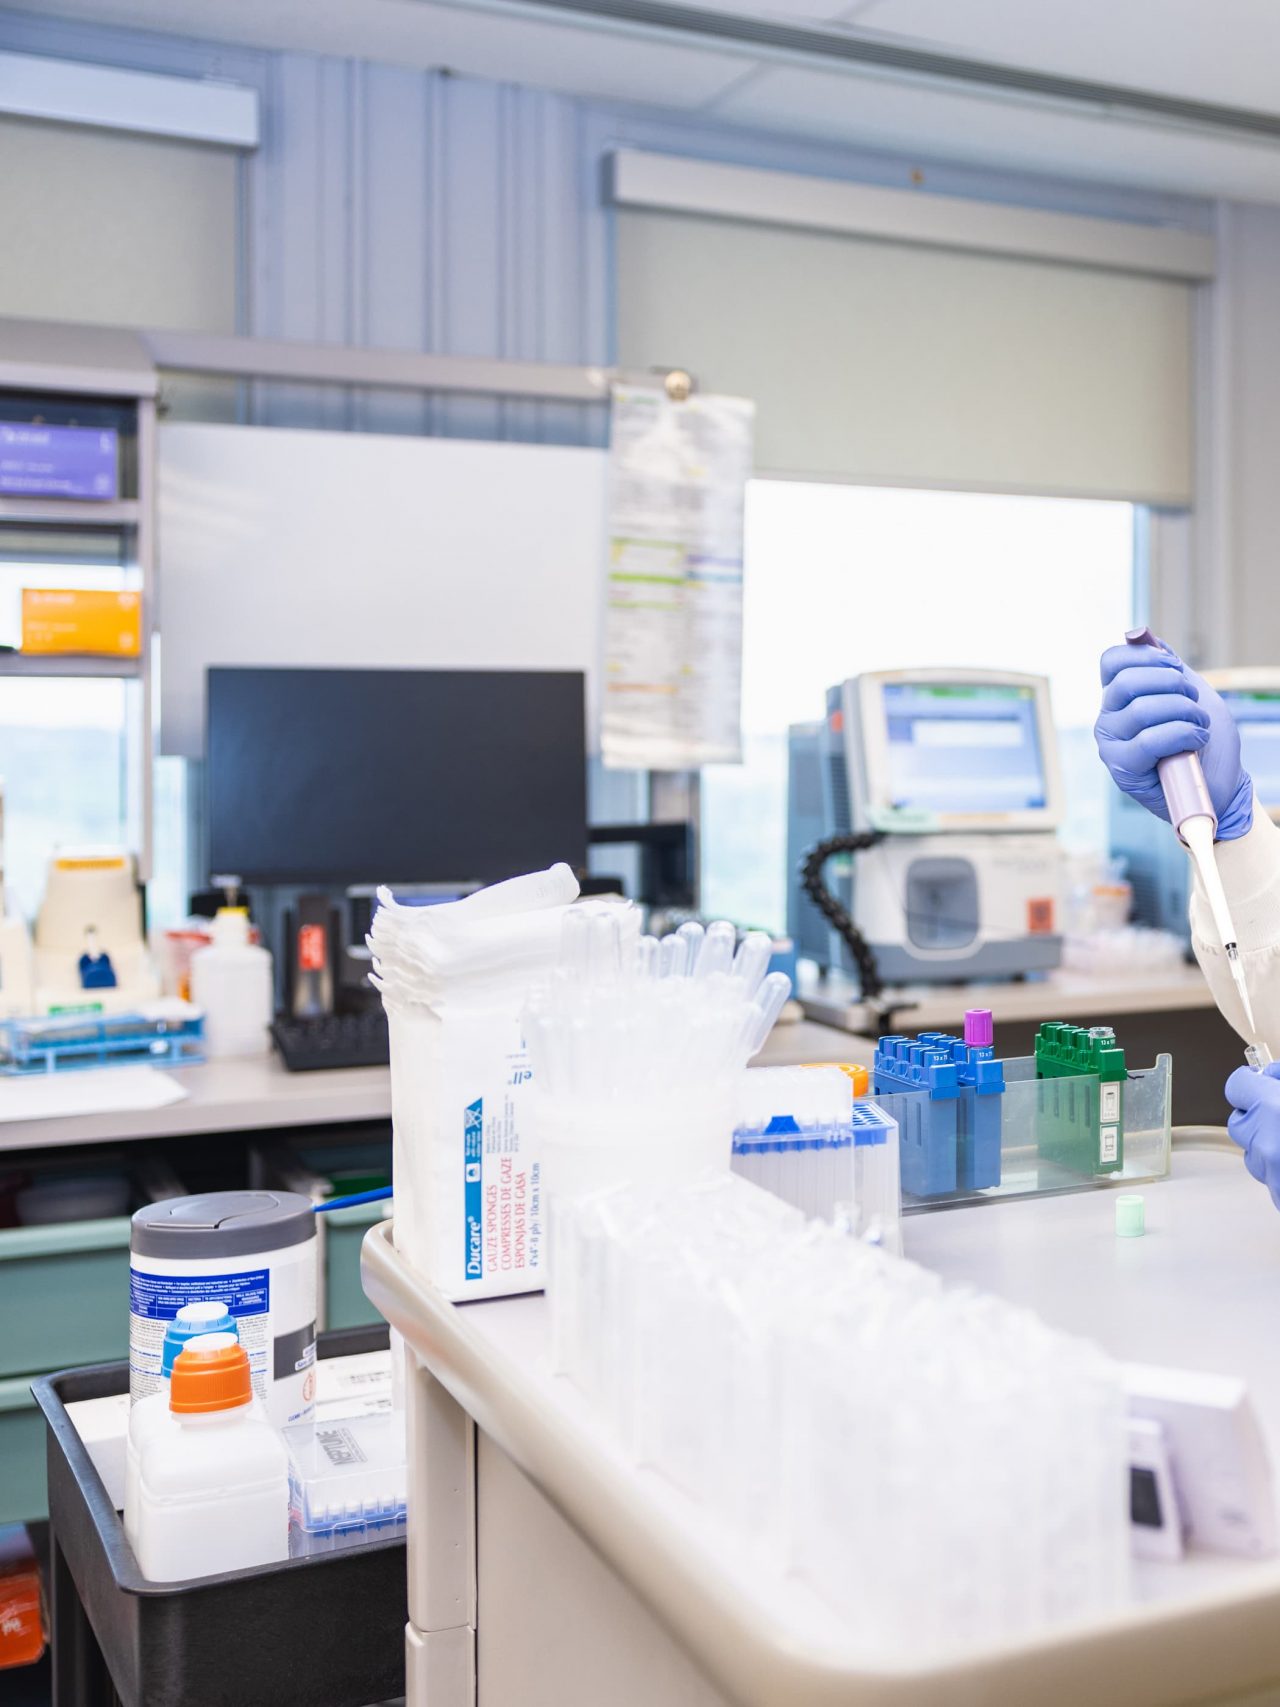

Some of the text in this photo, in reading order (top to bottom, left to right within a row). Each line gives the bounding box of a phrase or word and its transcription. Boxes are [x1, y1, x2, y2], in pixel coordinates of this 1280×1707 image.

[501, 1156, 512, 1184] GAZE
[501, 1187, 512, 1201] DE
[487, 1184, 498, 1272] GAUZE SPONGES
[501, 1203, 512, 1270] COMPRESSES
[514, 1172, 526, 1269] ESPONJAS DE GASA
